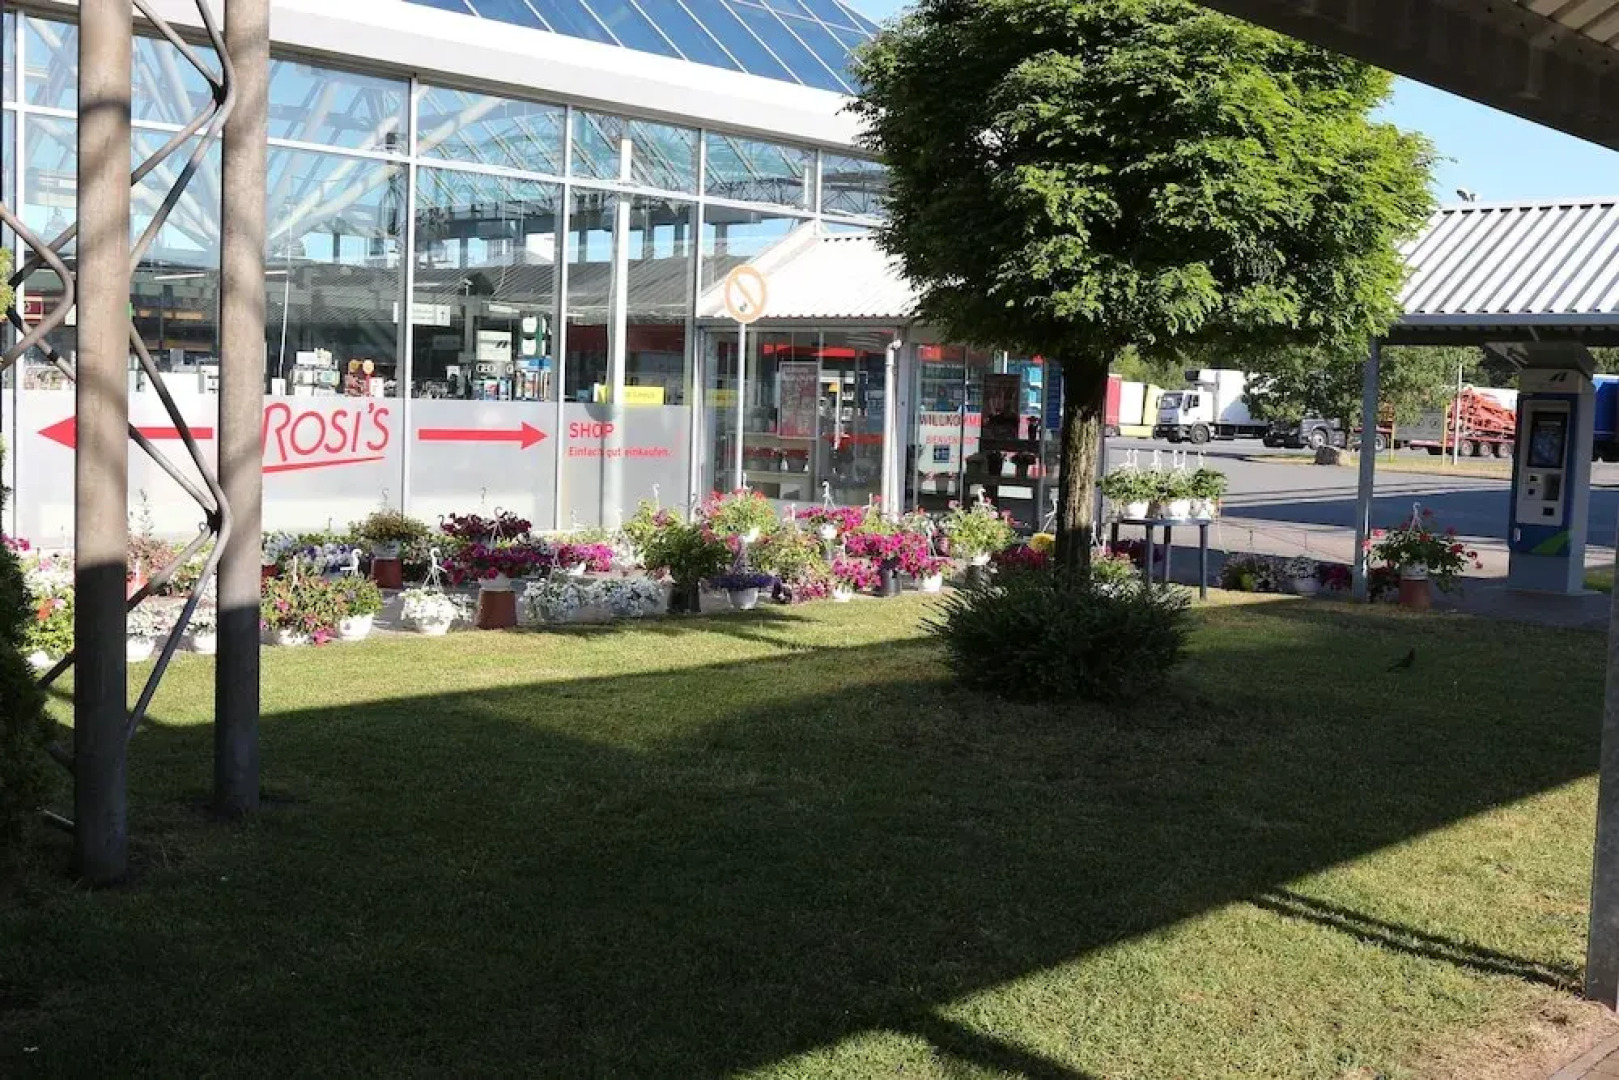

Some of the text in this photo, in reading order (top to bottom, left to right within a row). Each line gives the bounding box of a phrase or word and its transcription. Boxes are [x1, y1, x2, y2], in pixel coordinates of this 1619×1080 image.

[261, 402, 389, 462] ROSI'S
[569, 423, 614, 438] SHOP
[569, 446, 604, 457] Einfach
[606, 448, 621, 459] gut
